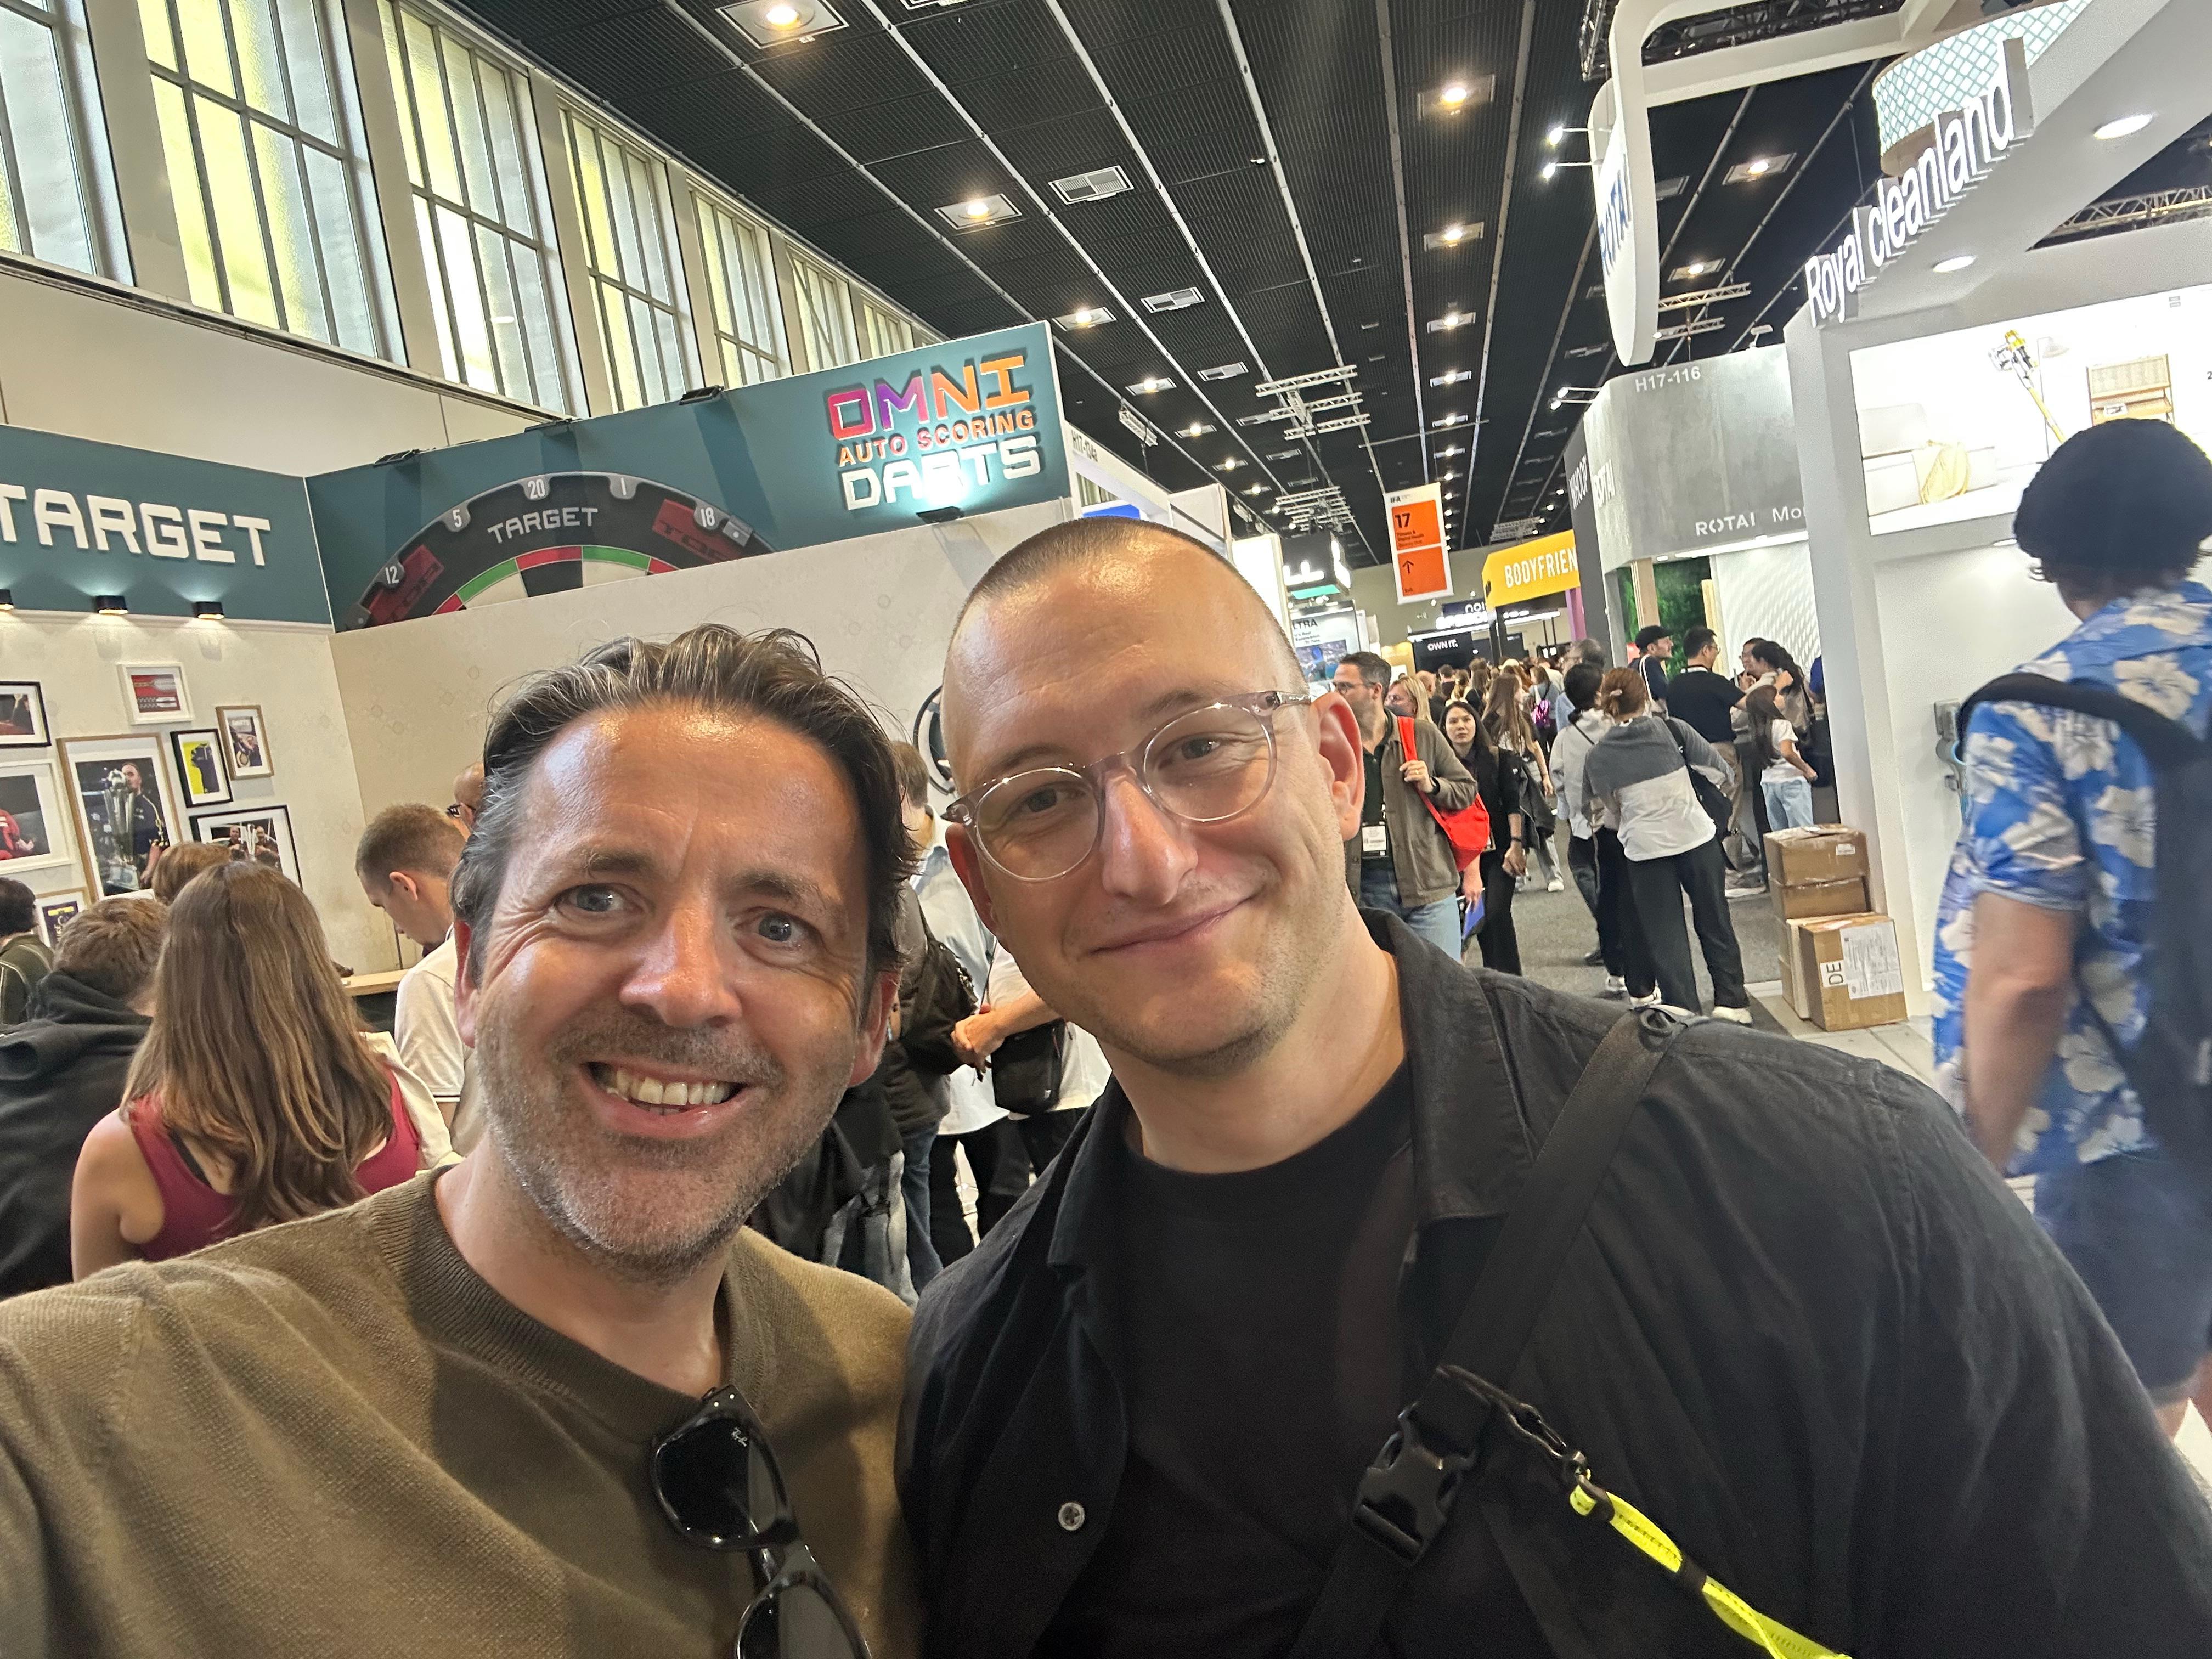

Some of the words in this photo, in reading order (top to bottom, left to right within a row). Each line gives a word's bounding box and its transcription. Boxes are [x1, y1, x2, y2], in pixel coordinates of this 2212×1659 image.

[1805, 206, 1865, 328] Royal
[1868, 40, 2014, 268] cleanland
[1635, 366, 1701, 392] H17-116
[827, 355, 1030, 441] OMNI
[839, 432, 907, 467] AUTO
[917, 409, 1034, 450] SCORING
[841, 435, 1041, 511] DARTS
[528, 479, 545, 499] 20
[620, 477, 627, 496] 1
[0, 483, 271, 566] TARGET
[452, 509, 462, 527] 5
[487, 507, 598, 543] TARGET
[700, 507, 715, 527] 18
[1395, 512, 1410, 528] 17
[1695, 511, 1756, 537] ROTAI
[1772, 505, 1806, 523] Mo
[385, 566, 399, 584] 12
[1427, 640, 1448, 651] OWN
[1826, 962, 1844, 985] DE
